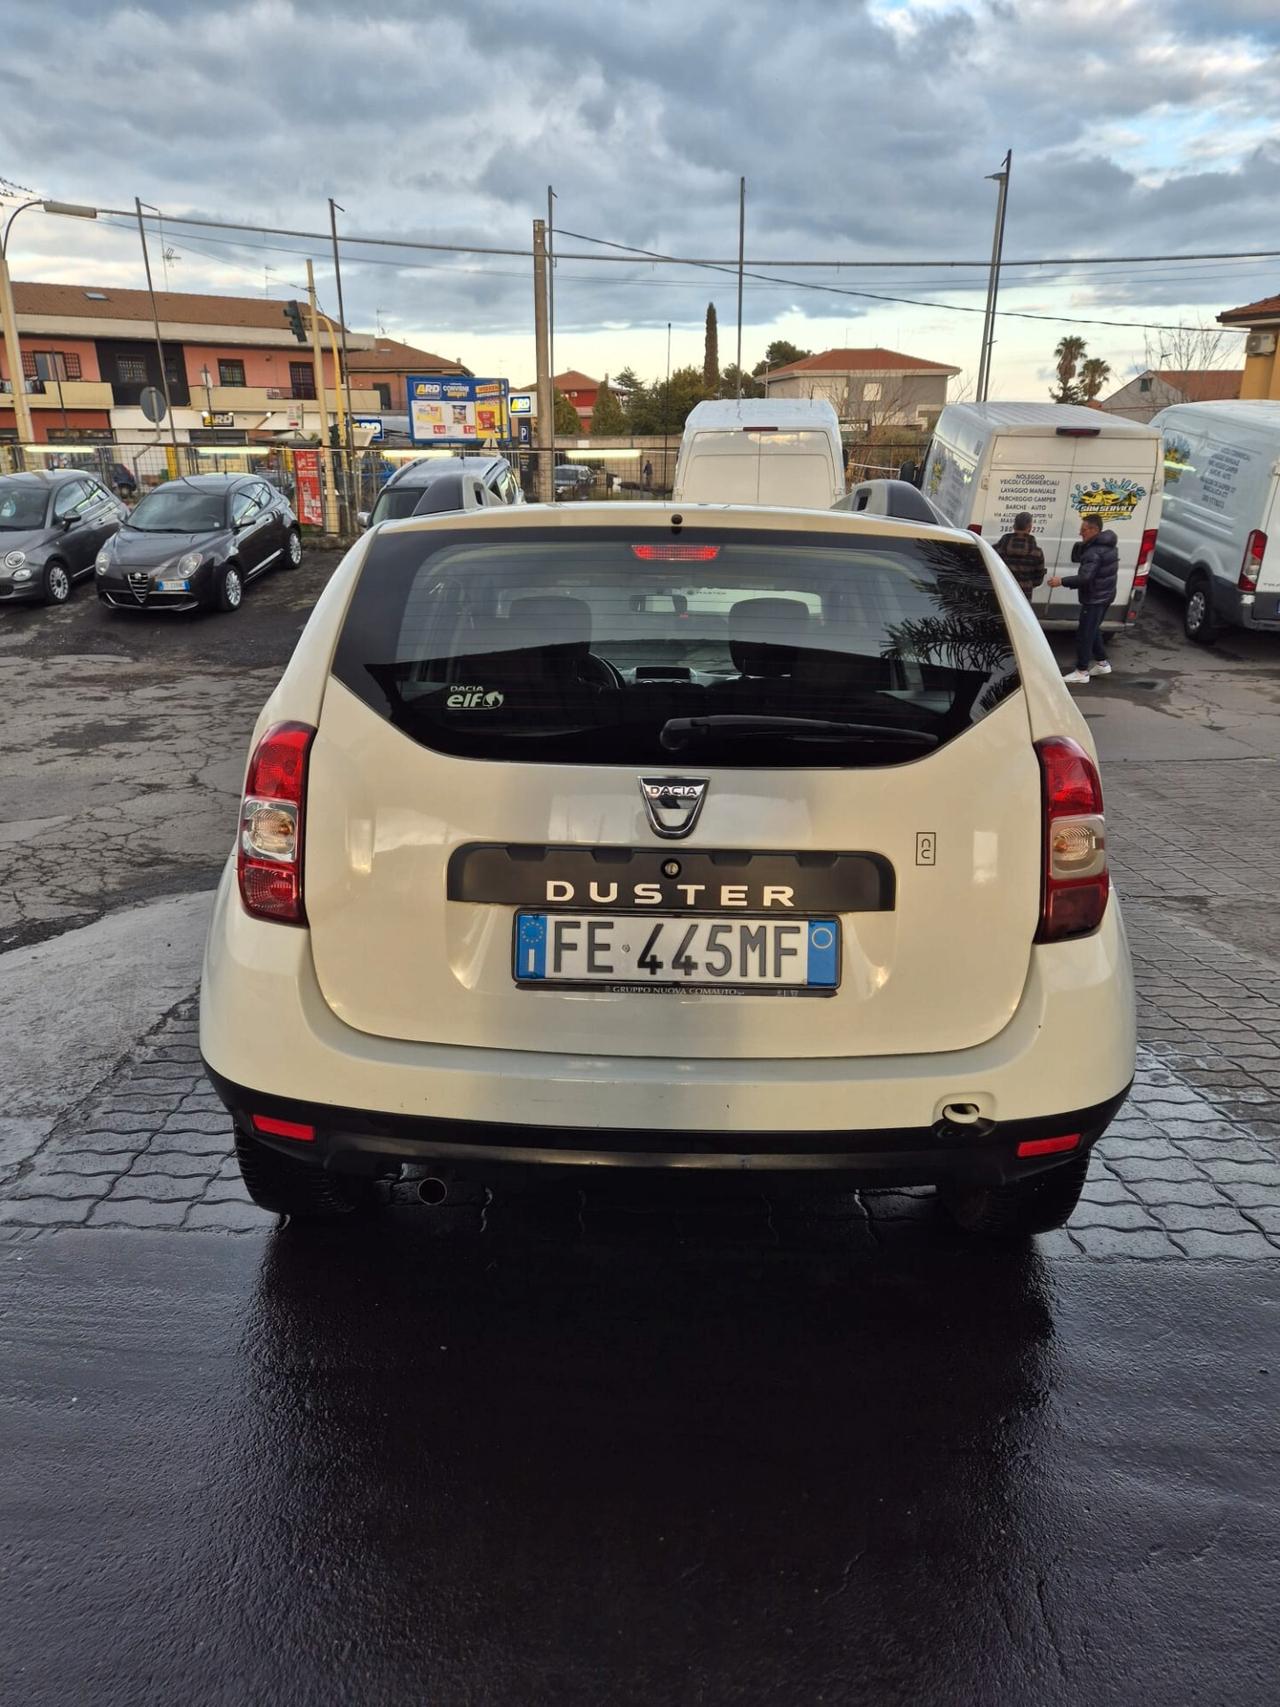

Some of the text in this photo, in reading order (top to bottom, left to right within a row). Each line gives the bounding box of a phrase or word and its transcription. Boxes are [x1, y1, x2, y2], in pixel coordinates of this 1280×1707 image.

[416, 384, 440, 395] ARD
[511, 398, 530, 411] ARD
[204, 414, 232, 425] ARD
[521, 428, 527, 440] P
[446, 693, 484, 707] elf
[650, 786, 697, 796] DACIA
[546, 880, 795, 907] DUSTER
[553, 921, 614, 974] FE
[637, 923, 801, 978] 445MF
[653, 986, 688, 994] NUOVA
[688, 987, 737, 995] COMAUTO
